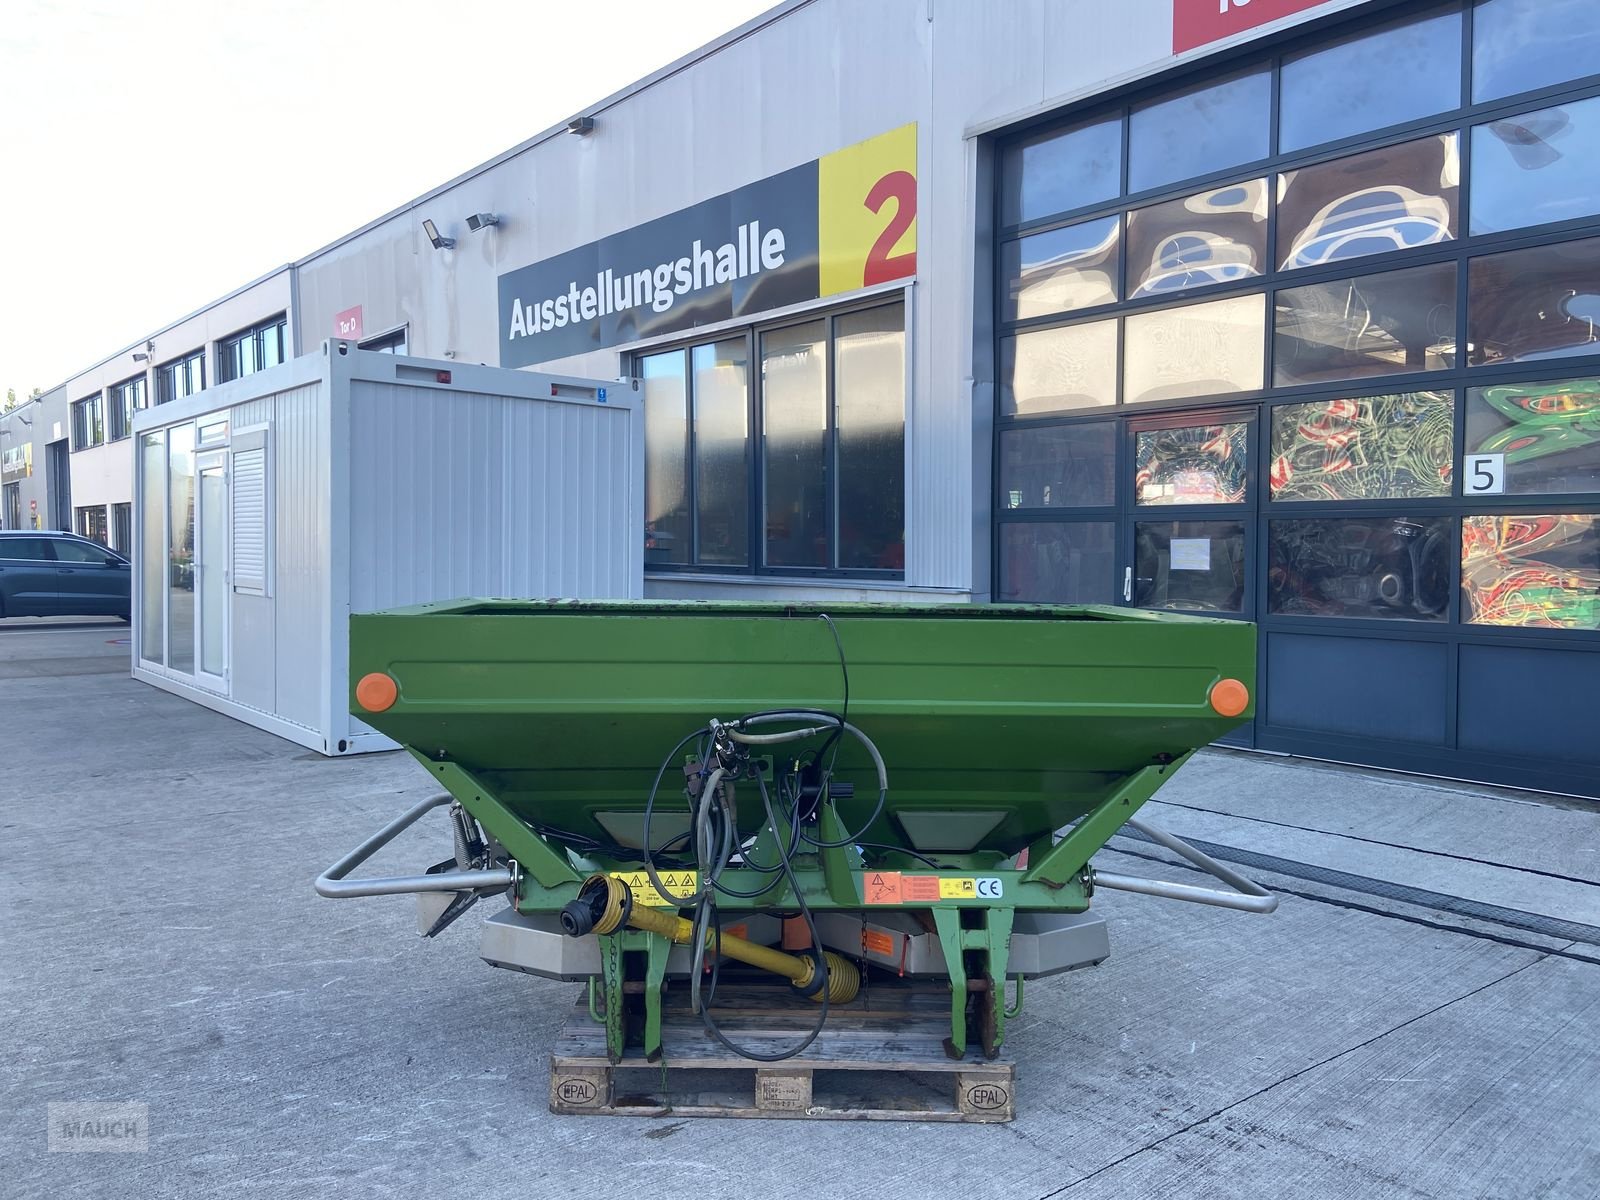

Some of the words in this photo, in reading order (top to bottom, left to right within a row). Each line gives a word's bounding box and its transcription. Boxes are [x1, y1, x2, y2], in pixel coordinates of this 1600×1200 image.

[508, 220, 786, 341] Ausstellungshalle
[863, 170, 917, 287] 2
[340, 321, 350, 335] Tor
[350, 317, 356, 331] D
[1472, 459, 1494, 491] 5
[977, 880, 1000, 896] CE
[563, 1084, 592, 1099] EPAL
[973, 1089, 1002, 1105] EPAL
